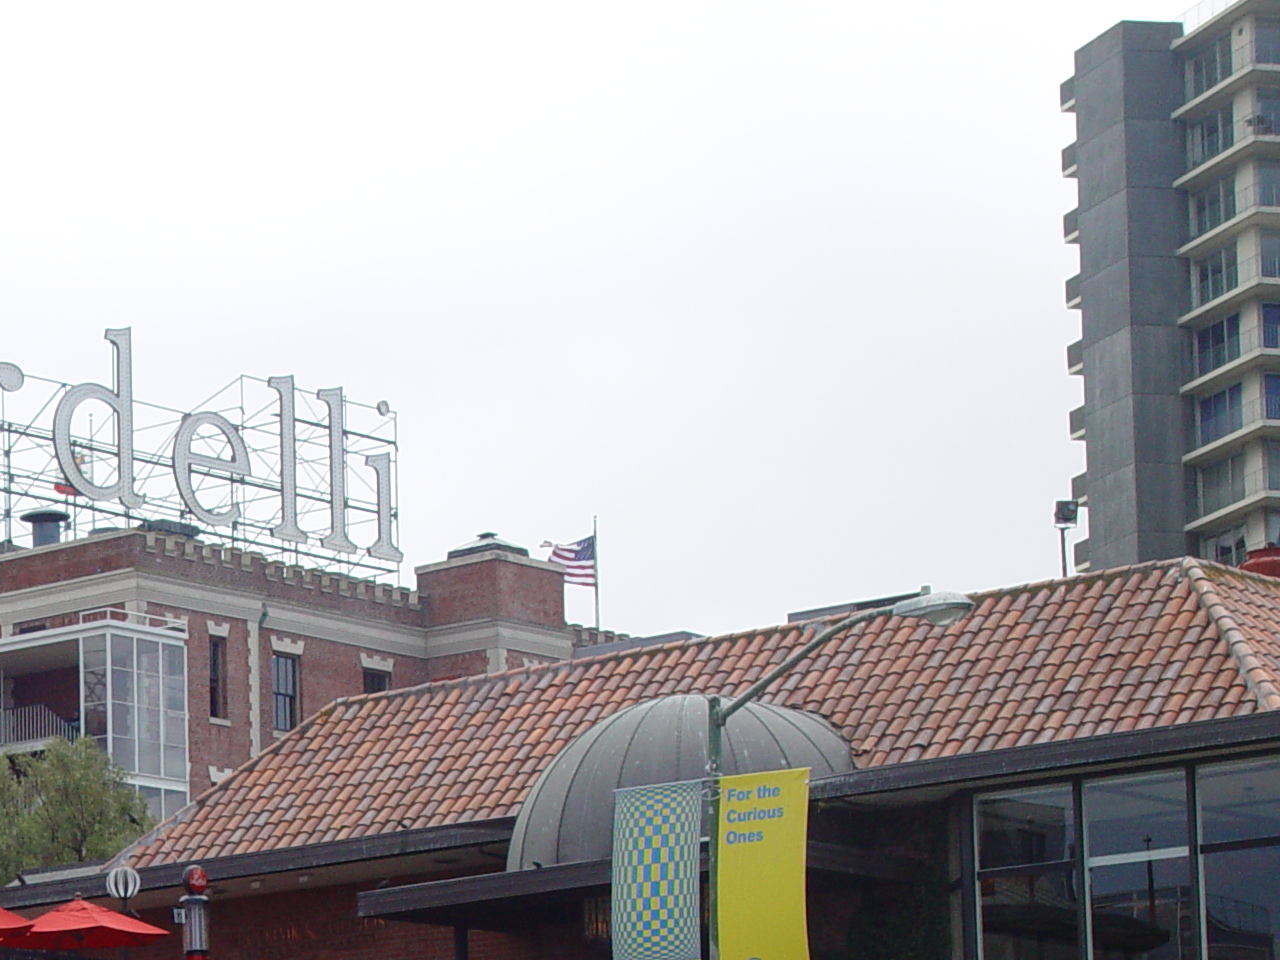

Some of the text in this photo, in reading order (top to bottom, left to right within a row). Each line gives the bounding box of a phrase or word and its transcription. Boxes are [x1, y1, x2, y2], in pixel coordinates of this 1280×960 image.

[726, 785, 781, 802] For the
[726, 808, 784, 823] Curious
[725, 831, 764, 845] Ones
